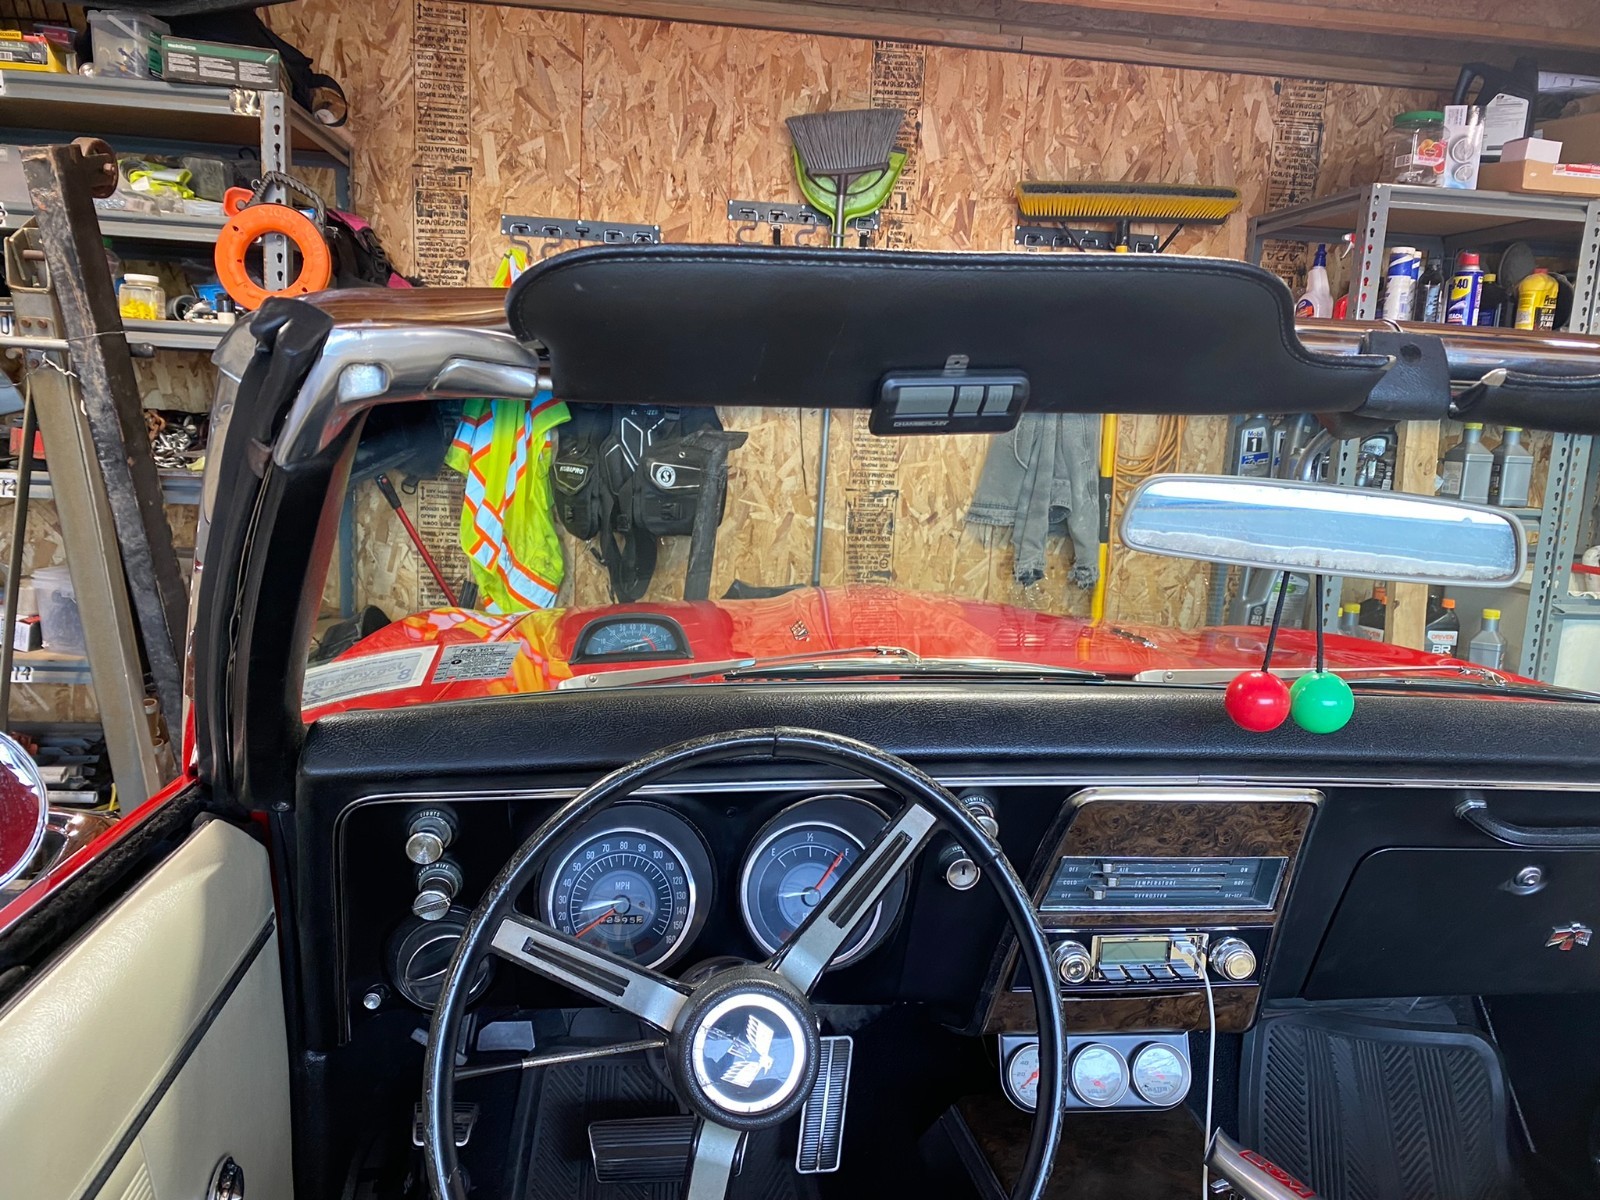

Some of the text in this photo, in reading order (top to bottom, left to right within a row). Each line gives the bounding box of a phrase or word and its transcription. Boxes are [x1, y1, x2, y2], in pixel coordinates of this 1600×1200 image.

[418, 145, 467, 154] INFORMATION
[1266, 252, 1299, 262] APA
[893, 420, 950, 428] CHAMBERLAIN
[1432, 645, 1451, 654] BR
[602, 844, 610, 852] 70
[619, 841, 629, 850] 80
[637, 843, 647, 852] 90
[586, 851, 595, 860] 60
[653, 850, 663, 859] 100
[771, 848, 776, 856] E
[845, 848, 850, 856] F
[572, 862, 581, 872] 50
[665, 862, 674, 871] 110
[563, 878, 572, 887] 40
[672, 876, 683, 885] 120
[615, 881, 630, 890] MPH
[558, 895, 567, 904] 30
[676, 891, 687, 900] 130
[676, 906, 687, 916] 140
[558, 912, 566, 921] 20
[673, 920, 683, 930] 150
[563, 926, 570, 934] 10
[665, 935, 676, 944] 160
